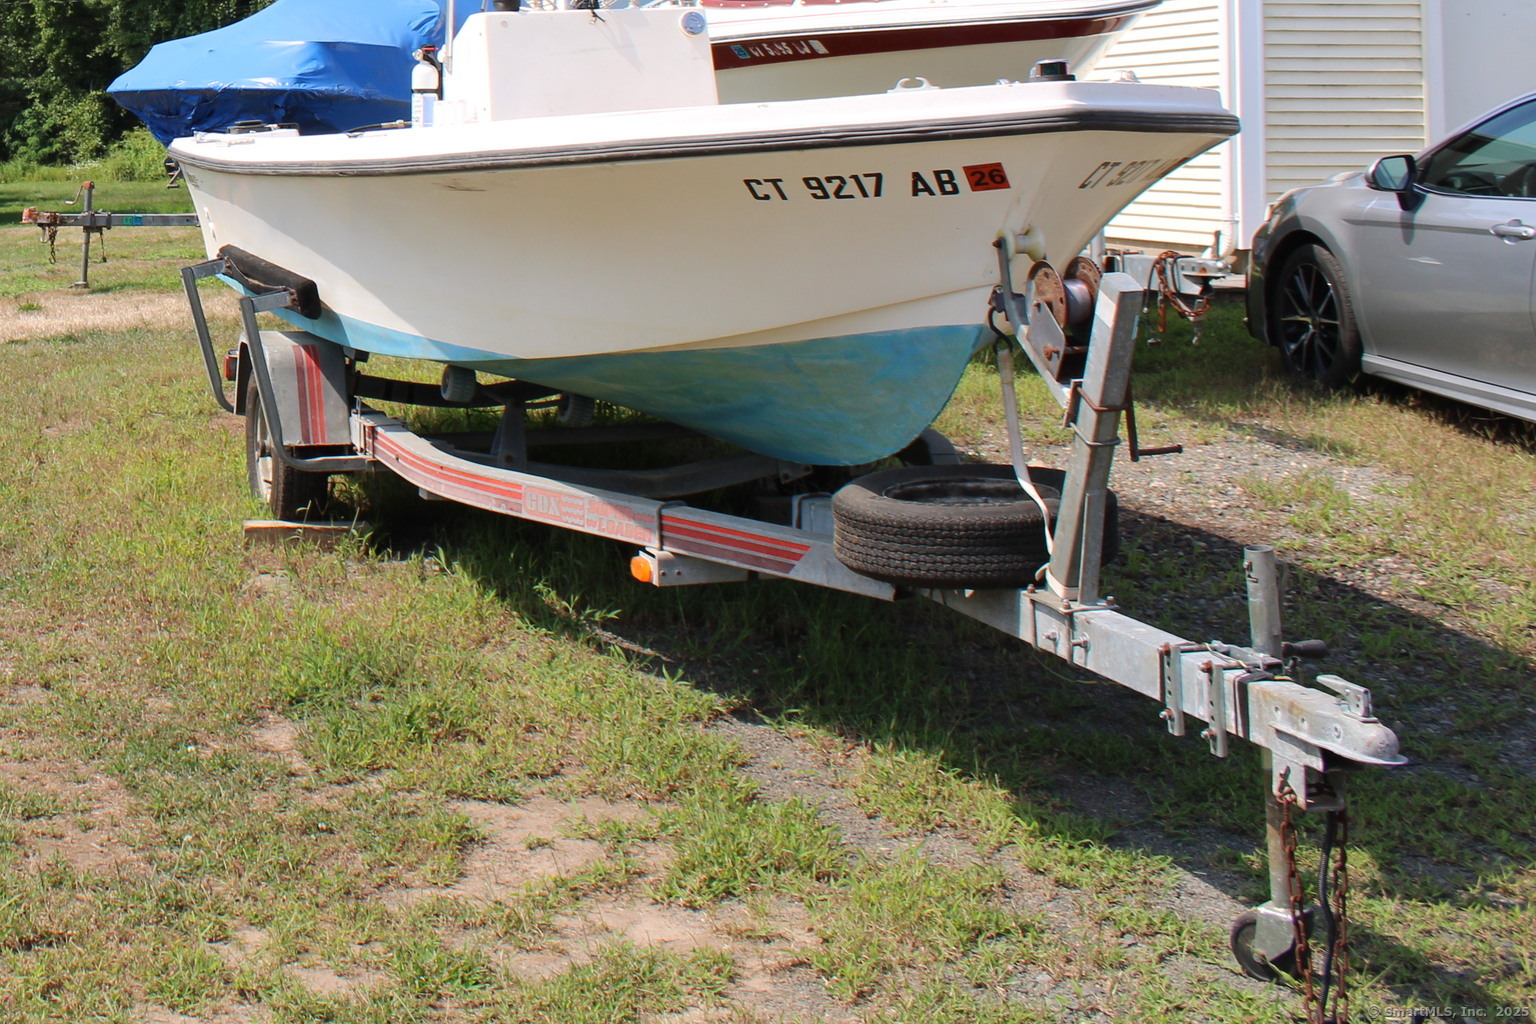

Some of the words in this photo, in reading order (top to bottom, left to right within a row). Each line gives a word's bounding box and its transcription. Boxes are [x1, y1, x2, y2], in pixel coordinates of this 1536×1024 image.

[743, 178, 788, 201] CT
[802, 172, 883, 200] 9217
[911, 169, 960, 197] AB
[970, 169, 1006, 186] 26
[1078, 161, 1122, 189] CT
[527, 492, 561, 516] COX
[597, 517, 654, 543] LOADER
